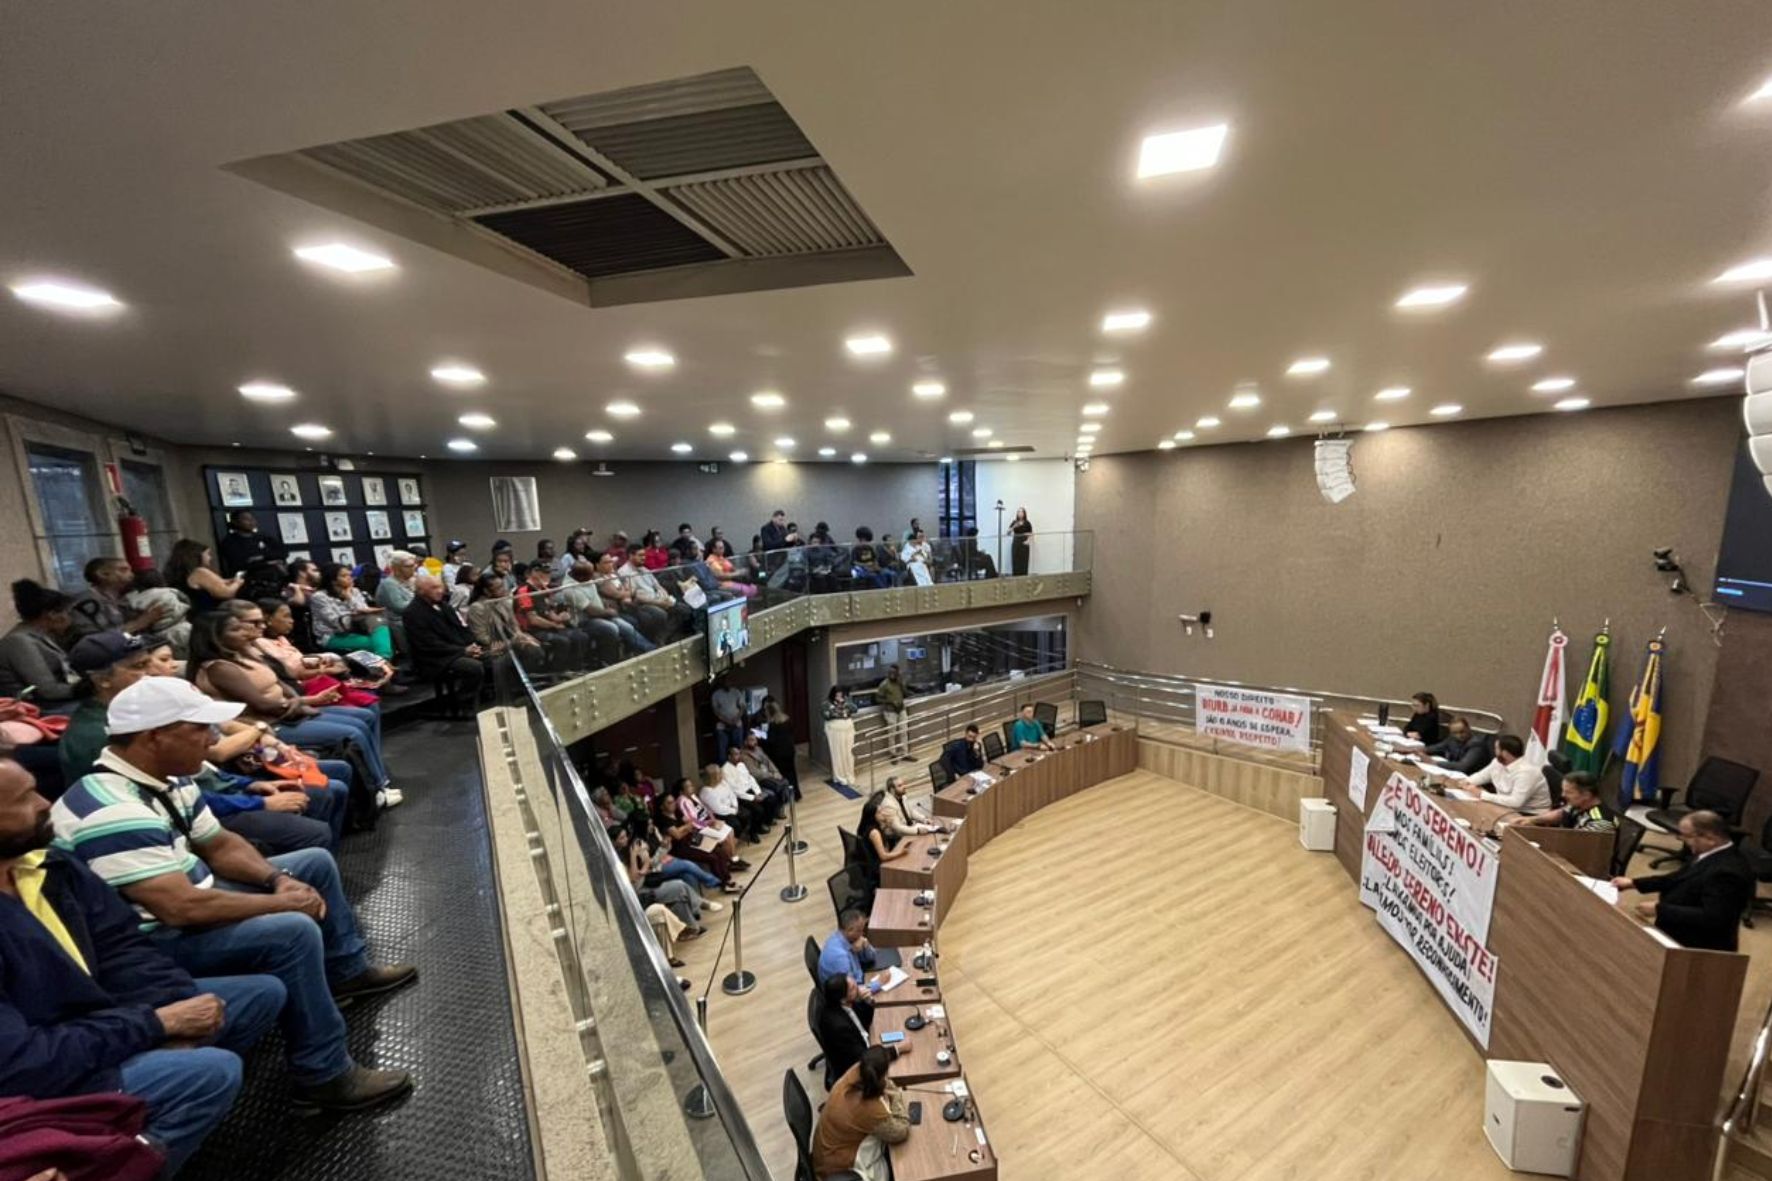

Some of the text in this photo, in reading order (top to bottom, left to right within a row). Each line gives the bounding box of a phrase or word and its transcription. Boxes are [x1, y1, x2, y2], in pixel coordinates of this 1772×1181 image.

[1214, 689, 1239, 700] NOSSO
[1405, 785, 1421, 816] DO
[1423, 803, 1485, 877] SERENO!
